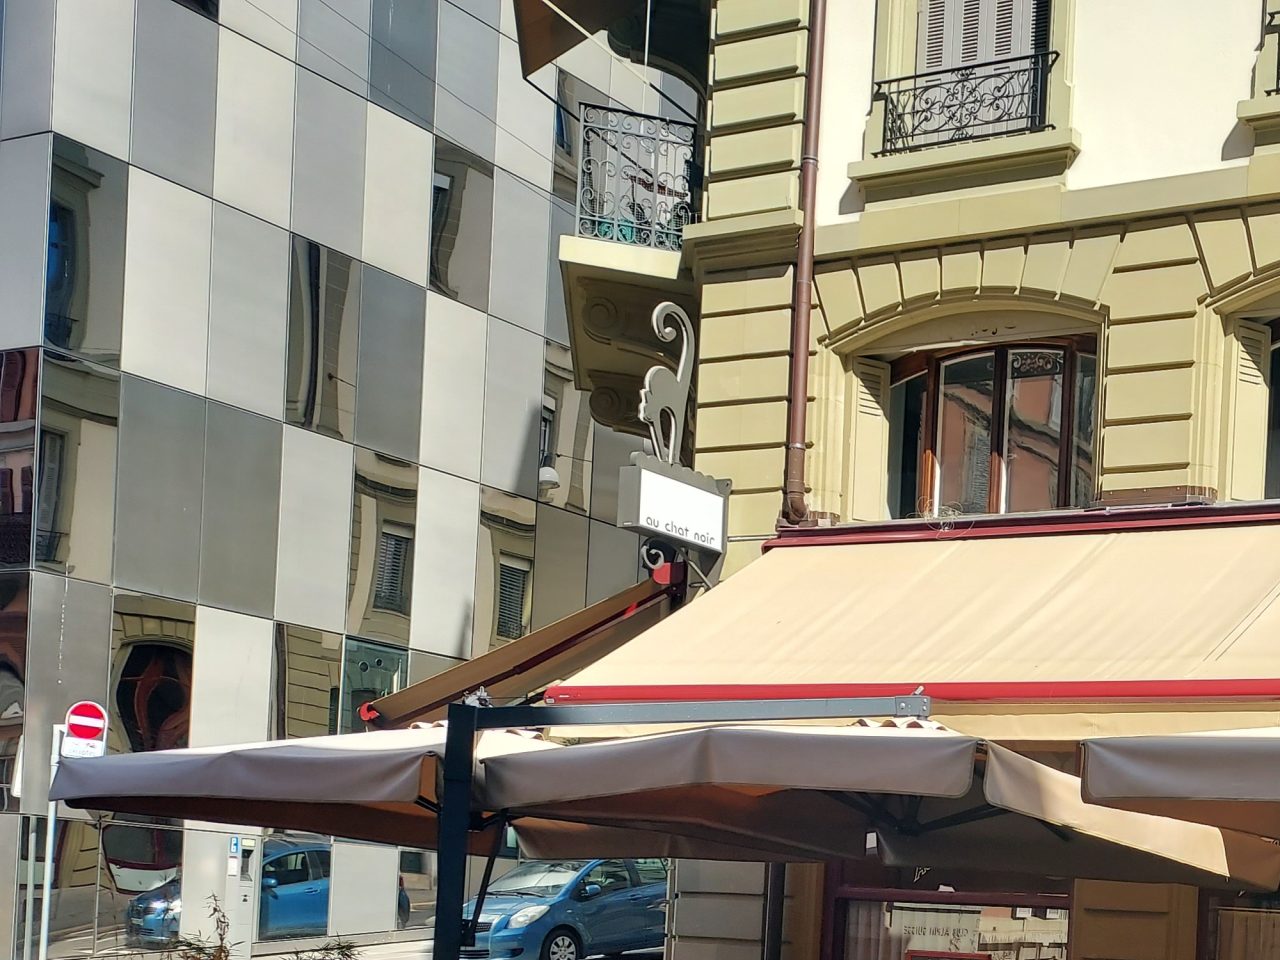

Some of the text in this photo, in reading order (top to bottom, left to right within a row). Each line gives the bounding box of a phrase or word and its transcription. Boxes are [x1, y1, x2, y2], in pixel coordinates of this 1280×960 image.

[645, 516, 716, 545] au chat noir
